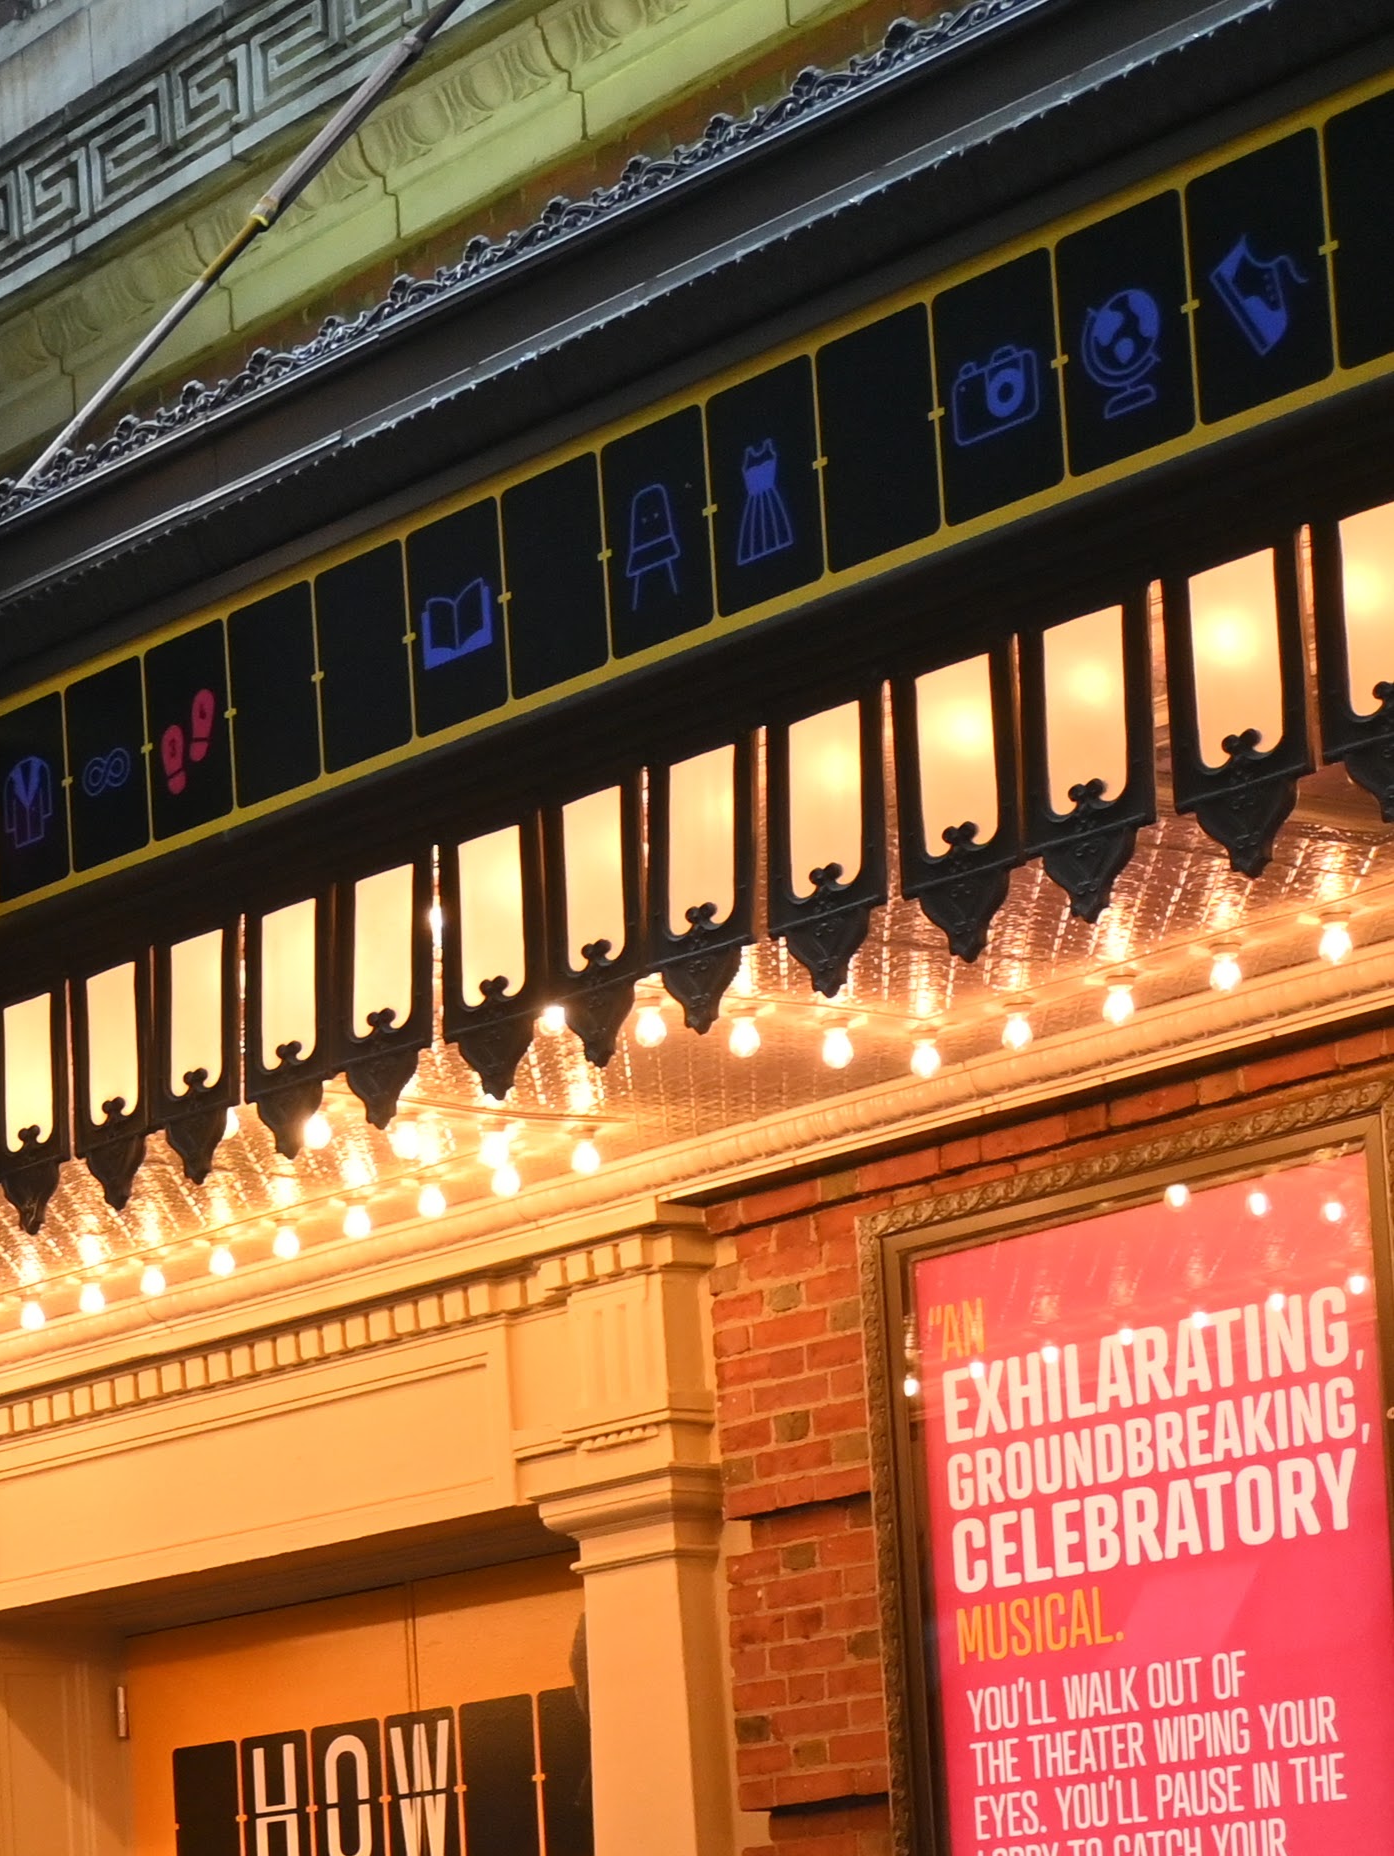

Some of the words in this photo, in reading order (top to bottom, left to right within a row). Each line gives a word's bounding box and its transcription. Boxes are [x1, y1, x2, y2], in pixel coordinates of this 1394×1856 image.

[928, 1297, 985, 1361] "AN
[942, 1286, 1365, 1443] EXHILARATING,
[947, 1376, 1370, 1510] GROUNDBREAKING,
[952, 1448, 1357, 1593] CELEBRATORY
[957, 1587, 1124, 1665] MUSICAL.
[966, 1676, 1057, 1733] YOU'LL
[1063, 1666, 1140, 1720] WALK
[1147, 1656, 1202, 1706] OUT
[1212, 1650, 1247, 1700] OF
[970, 1738, 1021, 1786] THE
[1027, 1721, 1147, 1780] THEATER
[1153, 1707, 1250, 1765] WIPING
[1259, 1696, 1339, 1750] YOUR
[974, 1790, 1047, 1841] EYES.
[1055, 1775, 1148, 1831] YOU'LL
[1155, 1765, 1244, 1820] PAUSE
[1252, 1763, 1280, 1809] IN
[1288, 1752, 1347, 1804] THE
